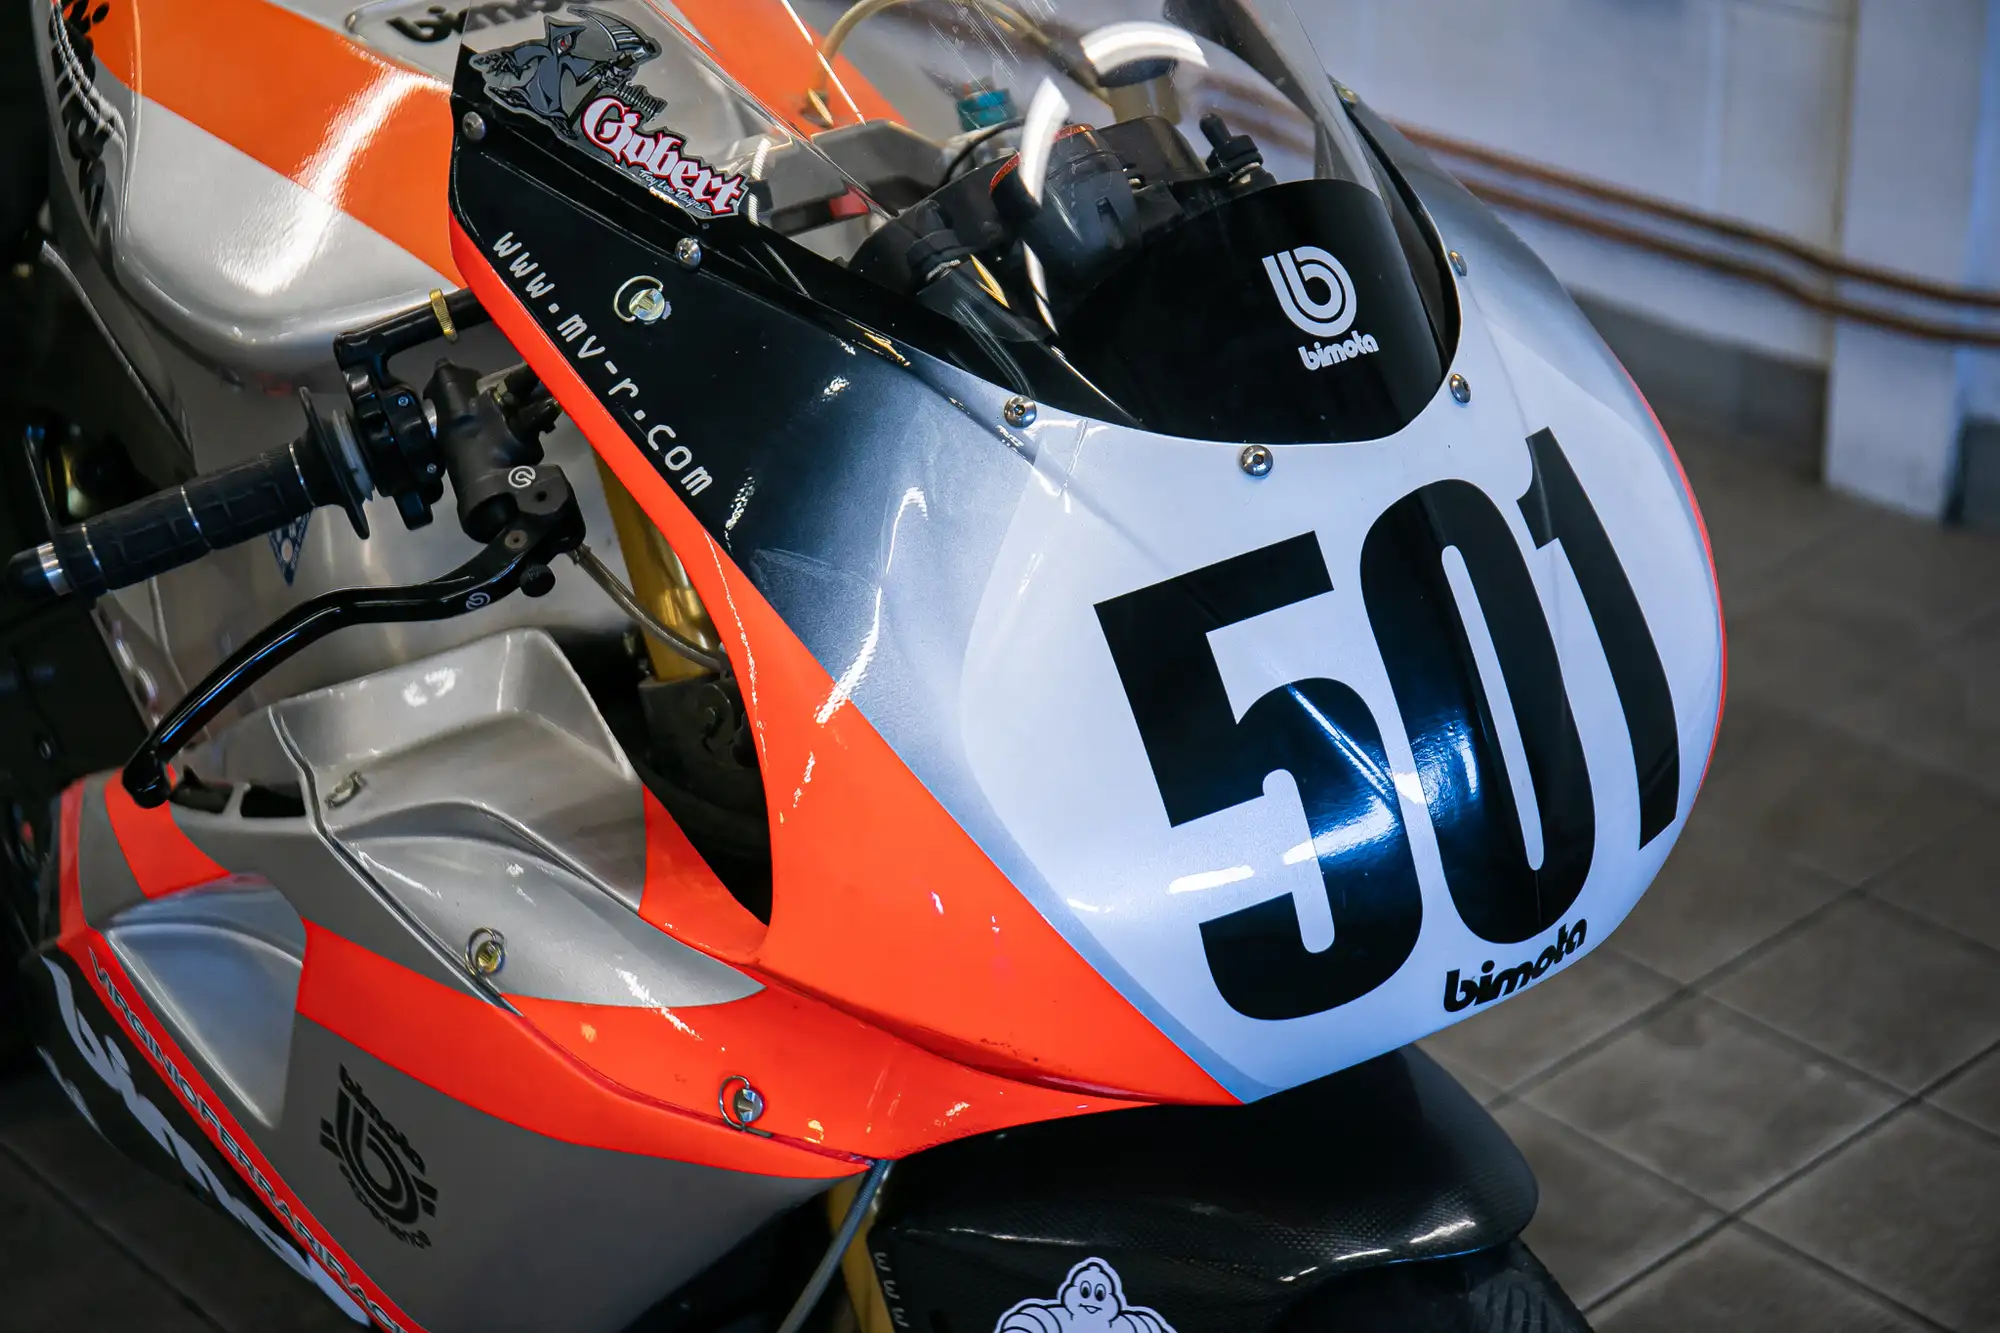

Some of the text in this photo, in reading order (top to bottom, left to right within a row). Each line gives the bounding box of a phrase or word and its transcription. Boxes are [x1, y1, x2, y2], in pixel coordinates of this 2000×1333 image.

[612, 79, 668, 122] Anthony
[581, 95, 743, 215] Gobert
[639, 169, 658, 188] Troy
[660, 179, 675, 195] Lee
[493, 231, 713, 496] www.mv-r.com
[1297, 330, 1380, 371] bimota
[1093, 426, 1680, 1021] 501
[1443, 918, 1588, 1013] bimota
